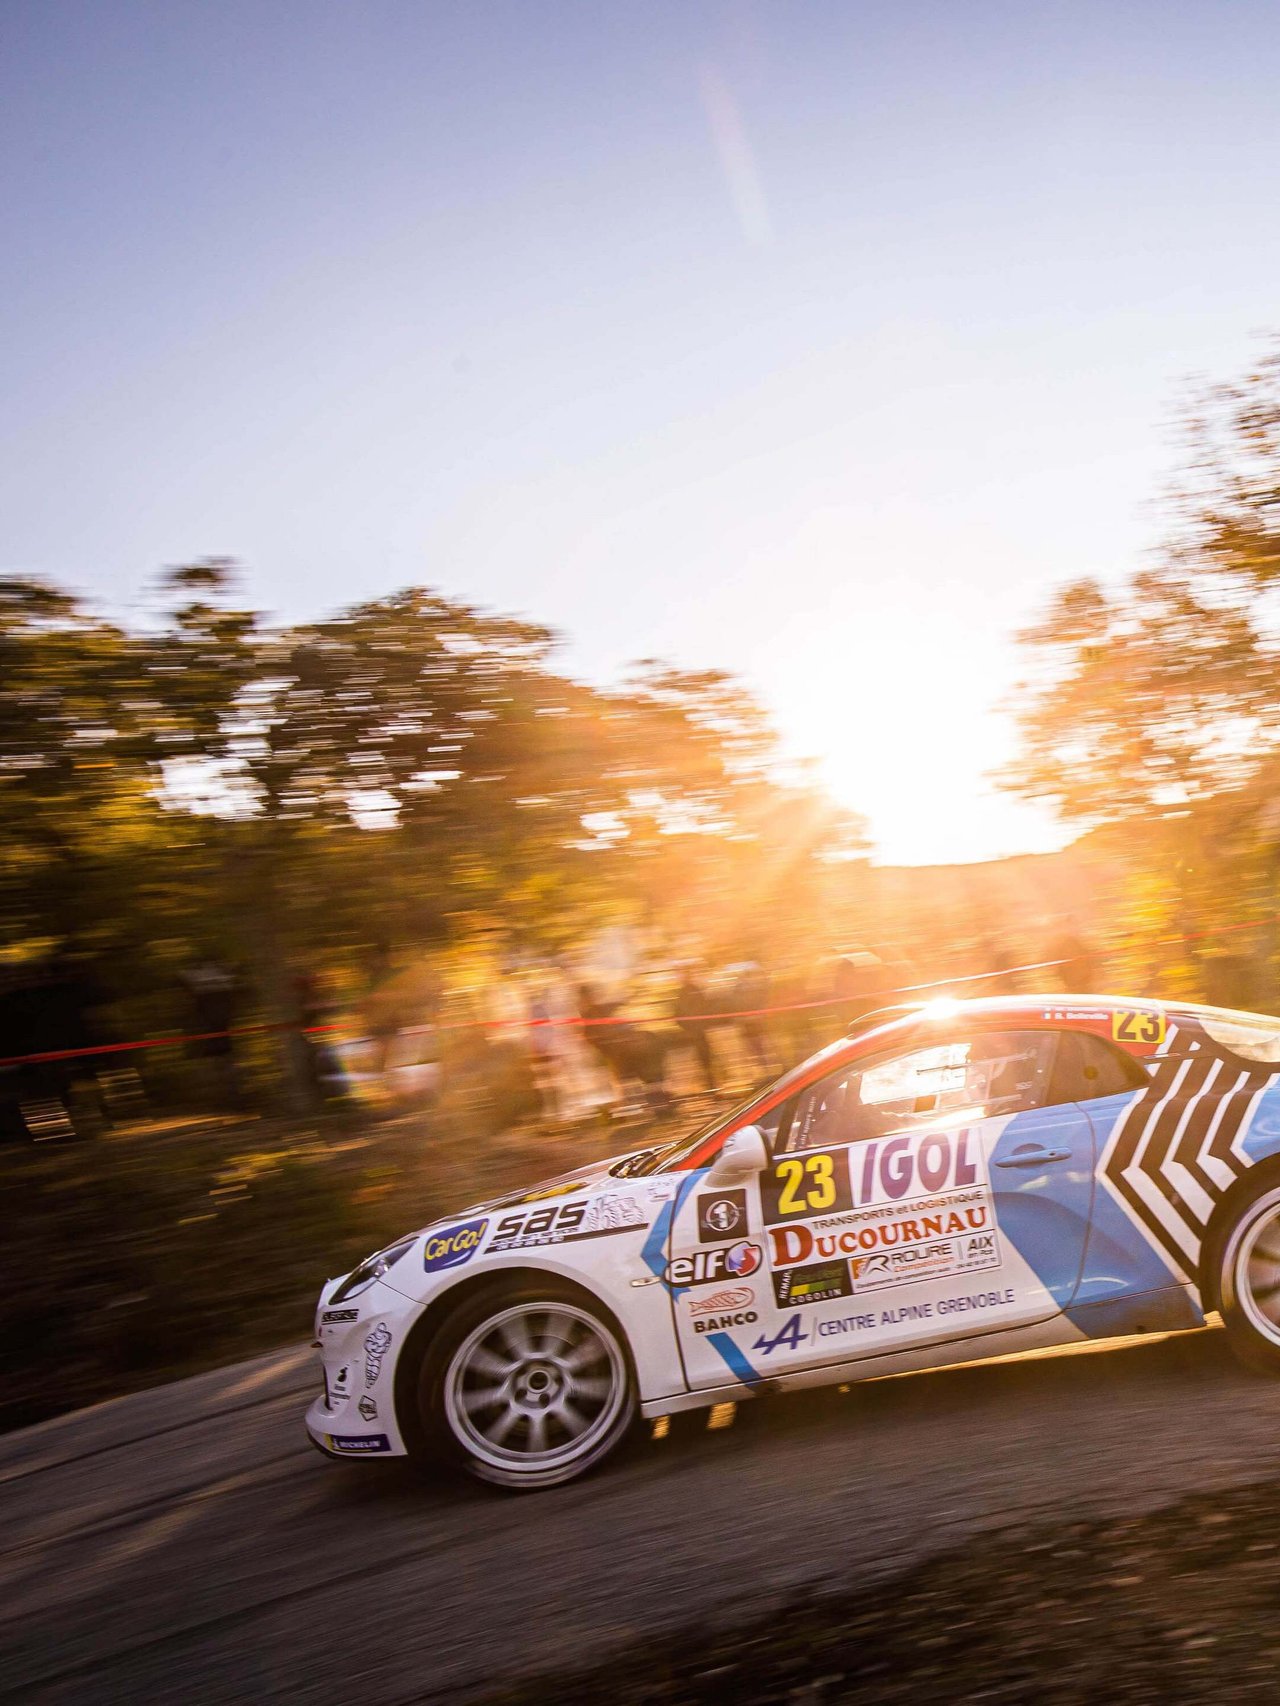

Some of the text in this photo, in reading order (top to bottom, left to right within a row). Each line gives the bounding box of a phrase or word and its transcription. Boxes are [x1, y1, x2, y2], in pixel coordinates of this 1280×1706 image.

[1117, 1010, 1160, 1042] 23
[859, 1129, 978, 1204] IGOL
[775, 1153, 837, 1215] 23
[812, 1191, 984, 1230] TRANSPORTS et LOGISTIQUE
[891, 1243, 953, 1264] ROURE
[967, 1236, 994, 1250] AIX
[667, 1250, 725, 1284] elf
[788, 1288, 842, 1304] COGOLIN
[693, 1311, 758, 1334] BAHCO
[818, 1289, 1015, 1337] CENTRE ALPINE GRENOBLE
